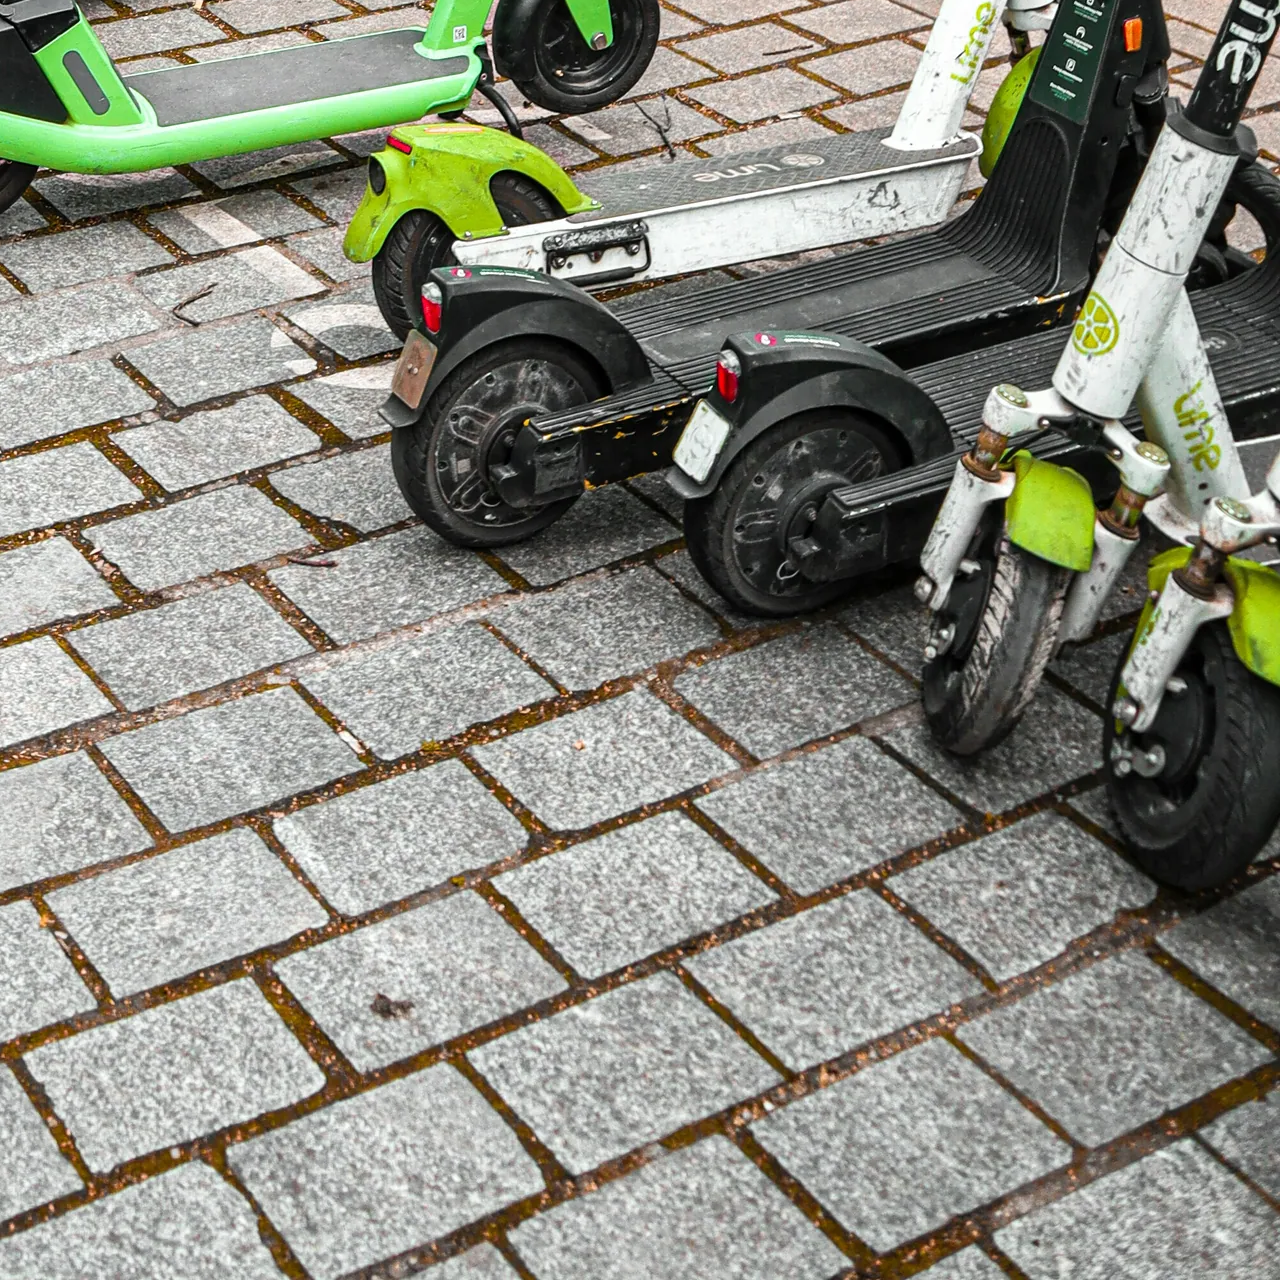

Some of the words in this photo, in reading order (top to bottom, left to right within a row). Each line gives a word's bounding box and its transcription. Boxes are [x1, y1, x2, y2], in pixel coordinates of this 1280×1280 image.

[950, 2, 996, 84] Lime
[692, 163, 783, 183] Lime
[1173, 380, 1222, 473] Lime
